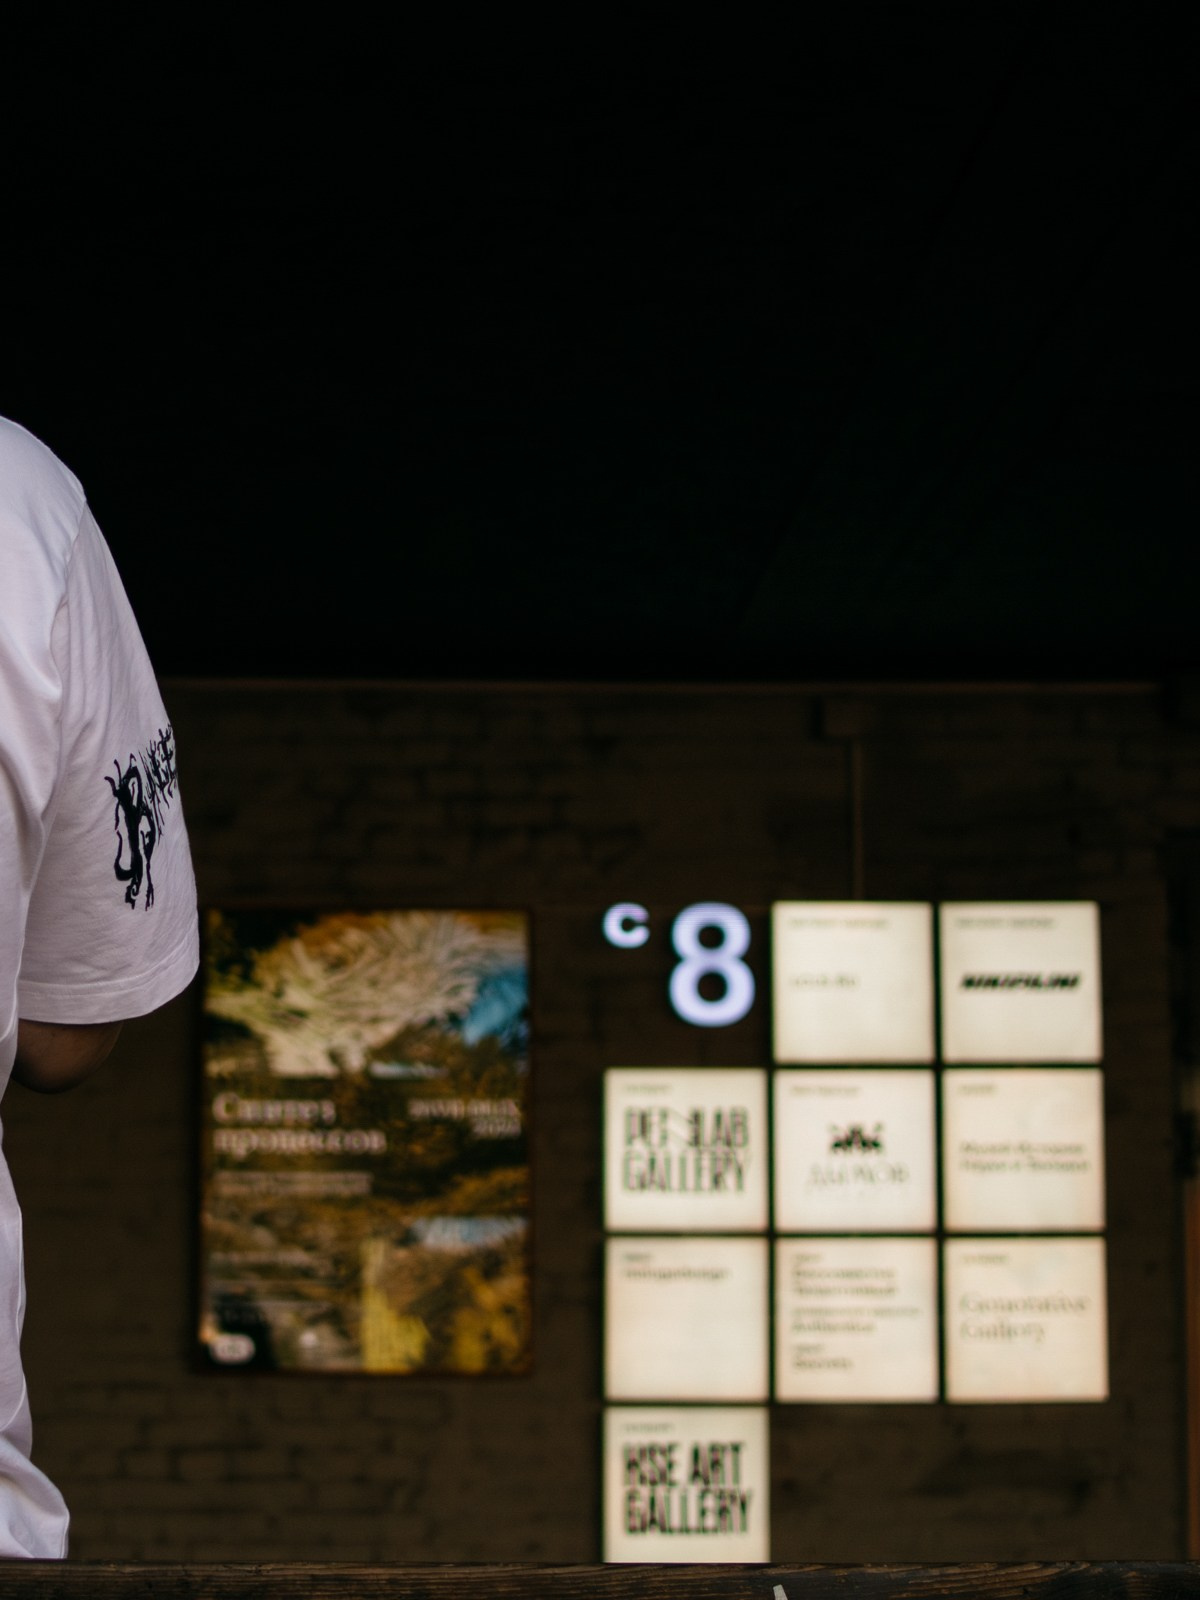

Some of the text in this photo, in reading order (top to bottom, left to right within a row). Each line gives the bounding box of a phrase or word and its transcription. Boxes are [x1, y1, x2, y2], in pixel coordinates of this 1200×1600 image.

[668, 901, 756, 1028] 8
[689, 1443, 745, 1486] ART
[625, 1488, 752, 1534] GALLERY
